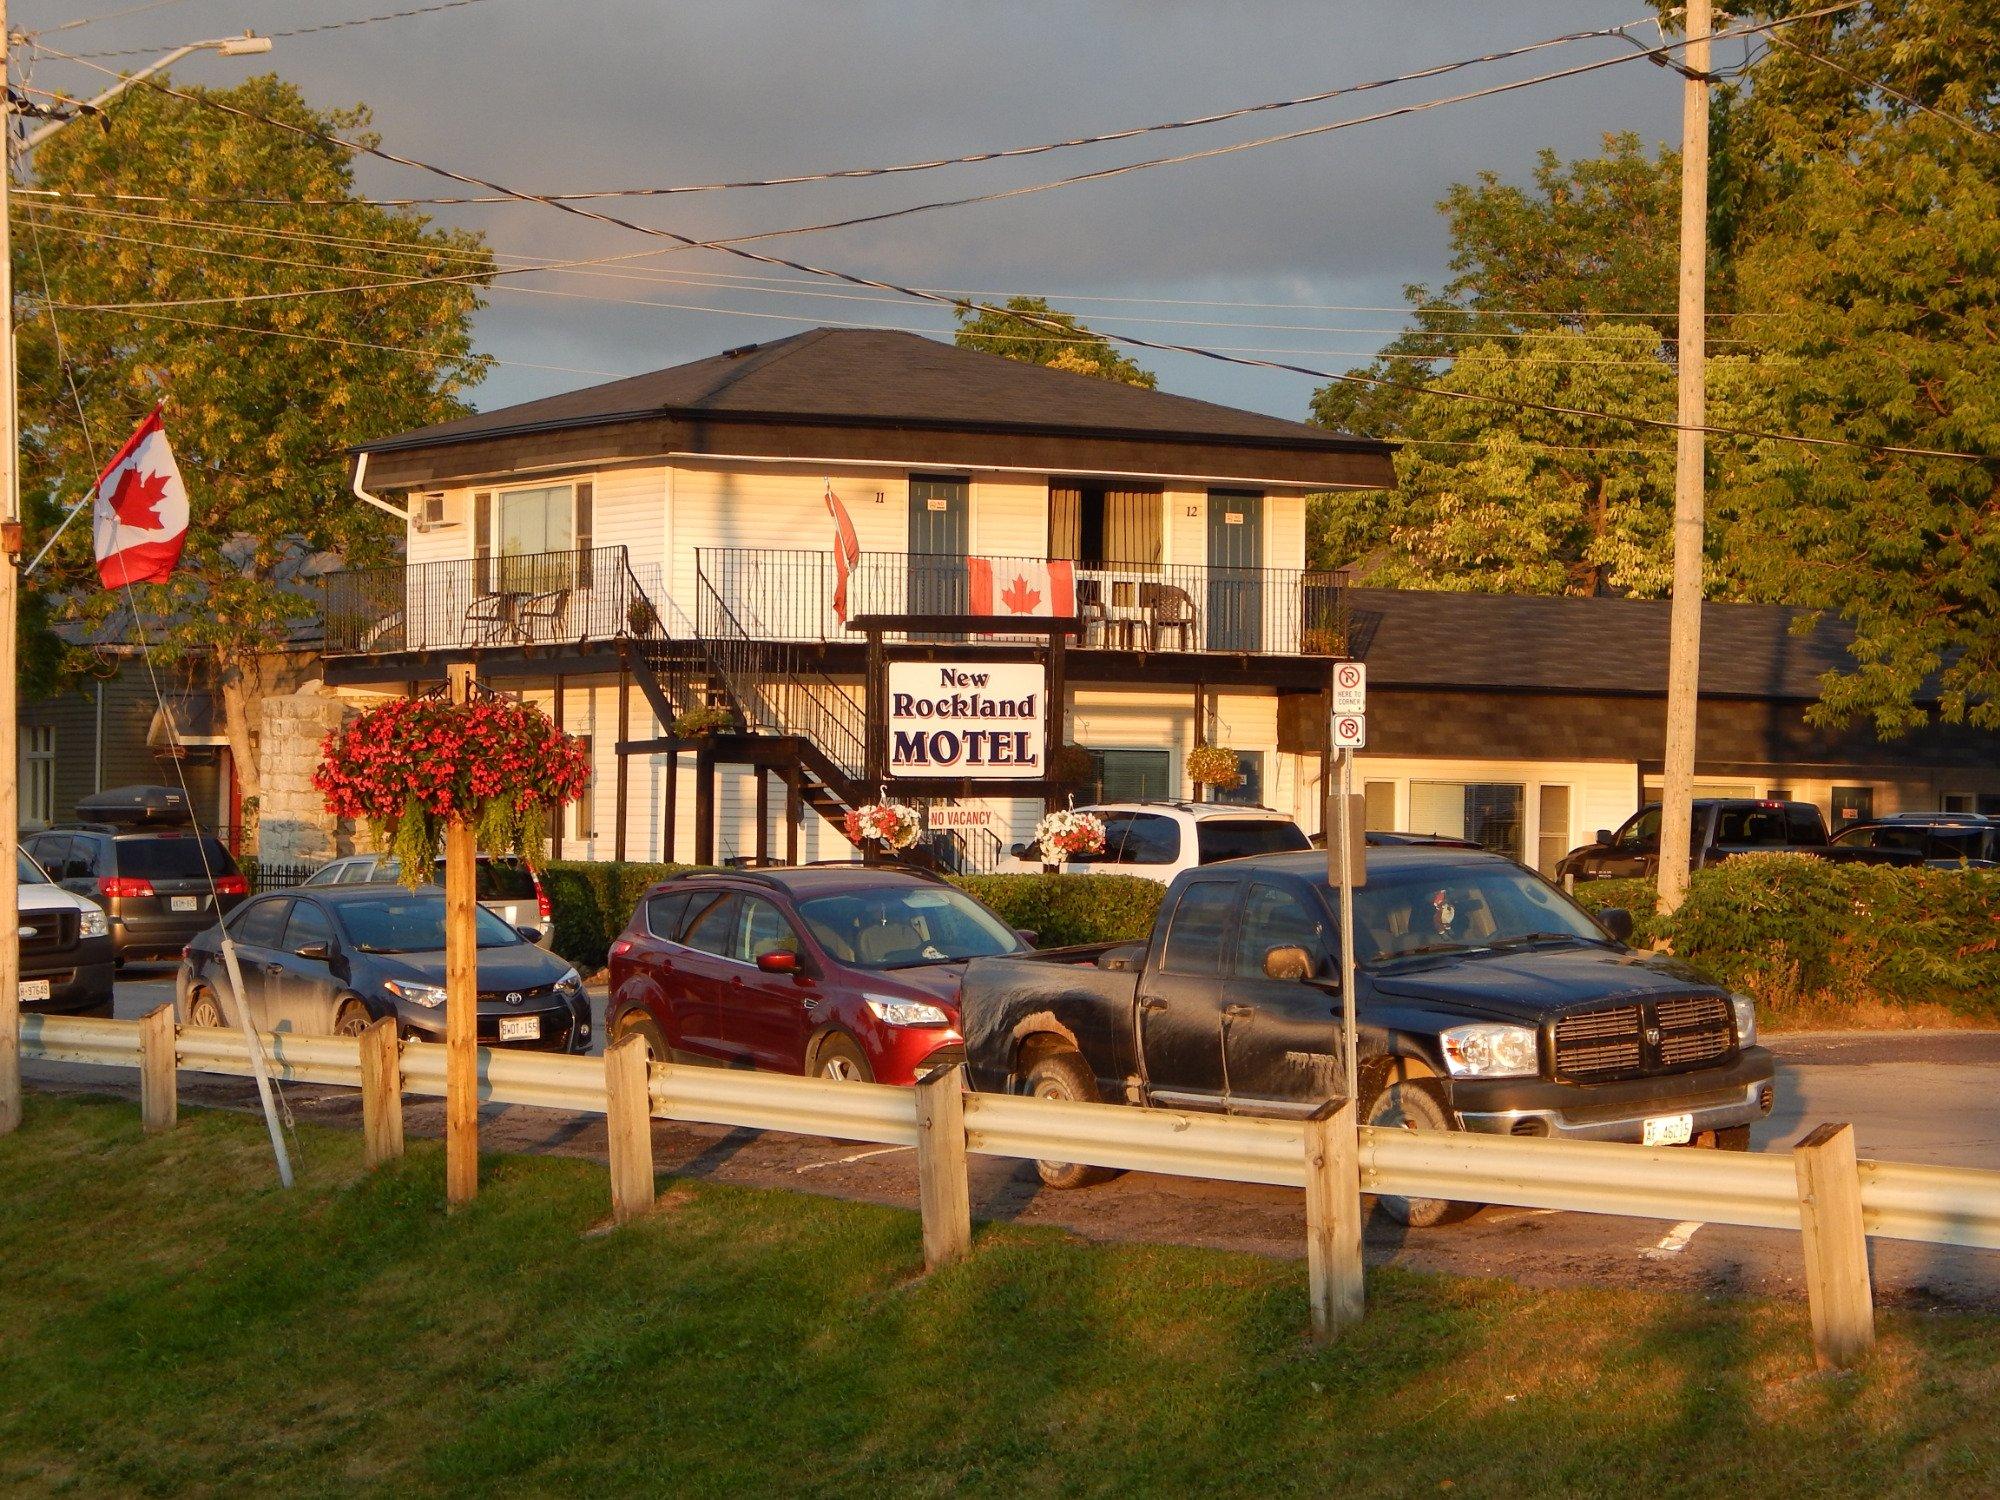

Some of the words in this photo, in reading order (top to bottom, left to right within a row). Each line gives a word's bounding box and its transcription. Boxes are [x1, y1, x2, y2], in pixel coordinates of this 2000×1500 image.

[875, 492, 885, 503] 11
[1186, 506, 1198, 517] 12
[940, 668, 989, 688] New
[1337, 690, 1352, 698] HERE
[1354, 690, 1362, 698] TO
[892, 693, 1037, 719] Rockland
[1338, 698, 1361, 706] CORNER
[892, 730, 1038, 767] MOTEL
[930, 812, 945, 826] NO
[947, 811, 992, 826] VACANCY
